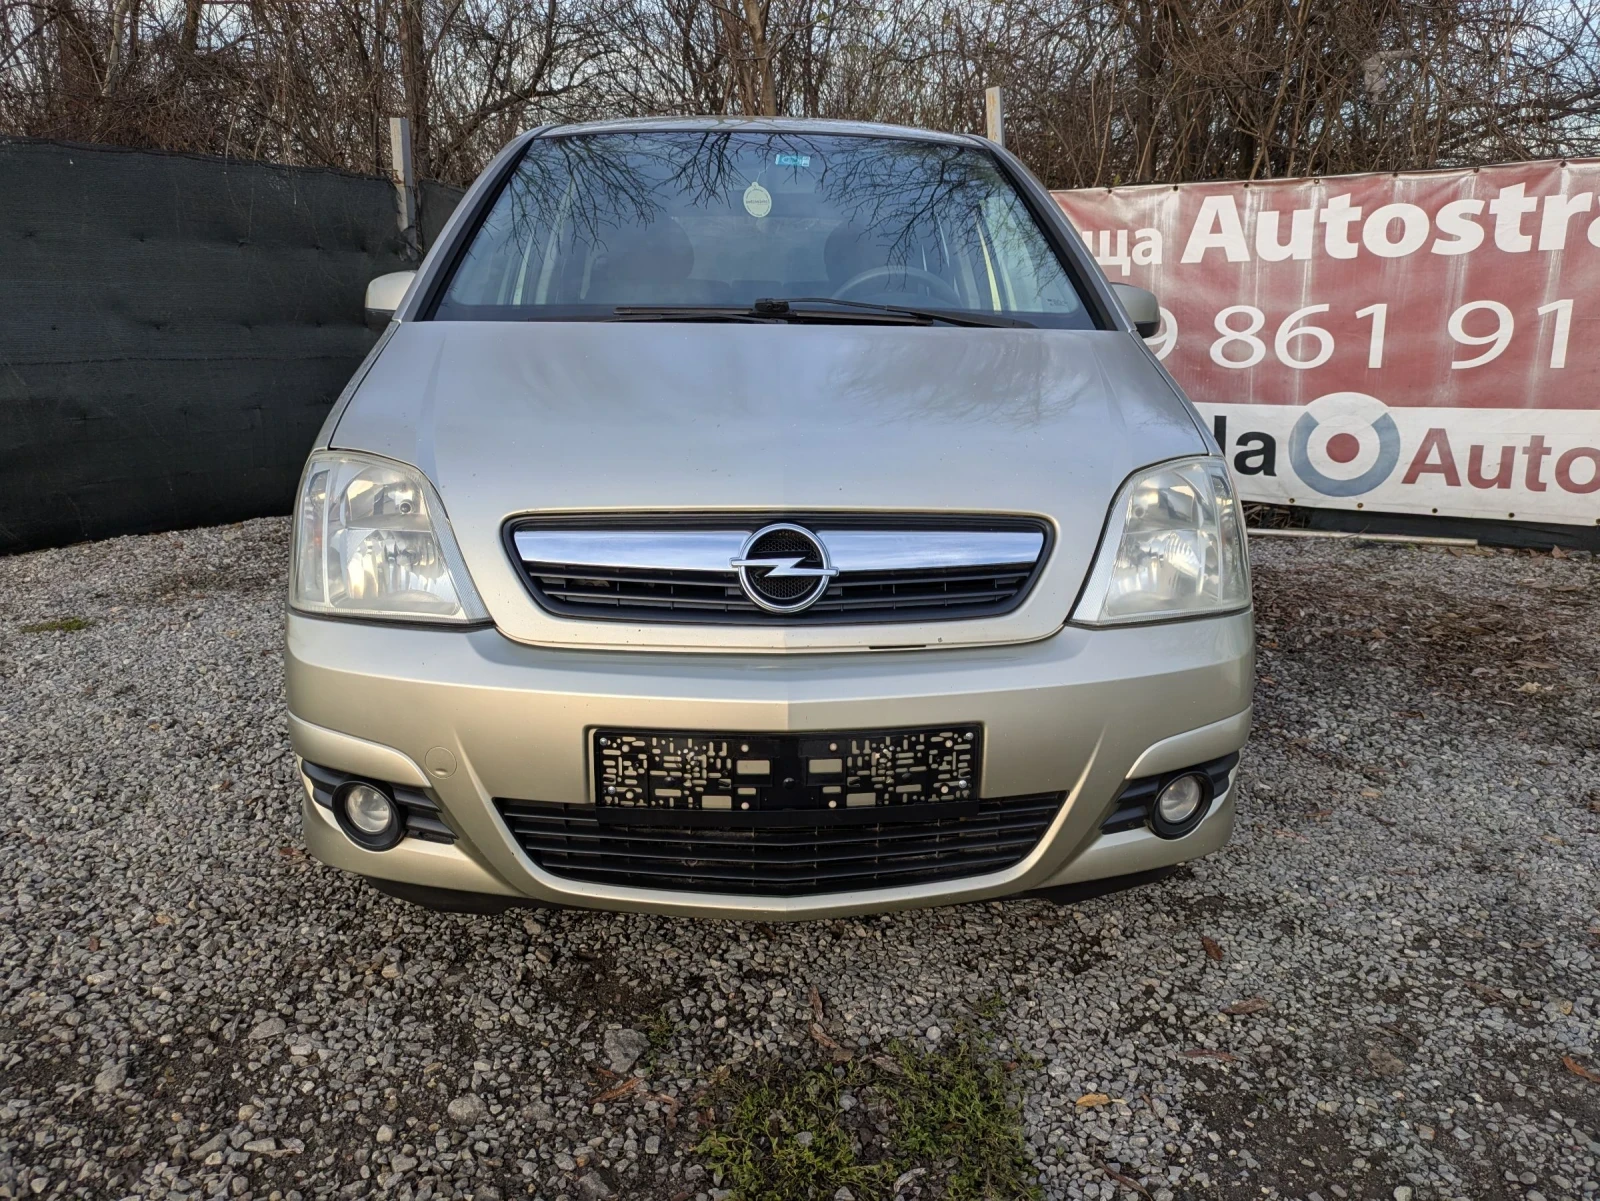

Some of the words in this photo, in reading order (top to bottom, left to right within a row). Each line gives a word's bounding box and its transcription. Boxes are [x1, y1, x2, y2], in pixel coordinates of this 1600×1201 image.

[1181, 182, 1600, 264] Autostr
[1209, 303, 1388, 369] 861
[1448, 299, 1574, 369] 91
[1401, 428, 1600, 494] Auto
